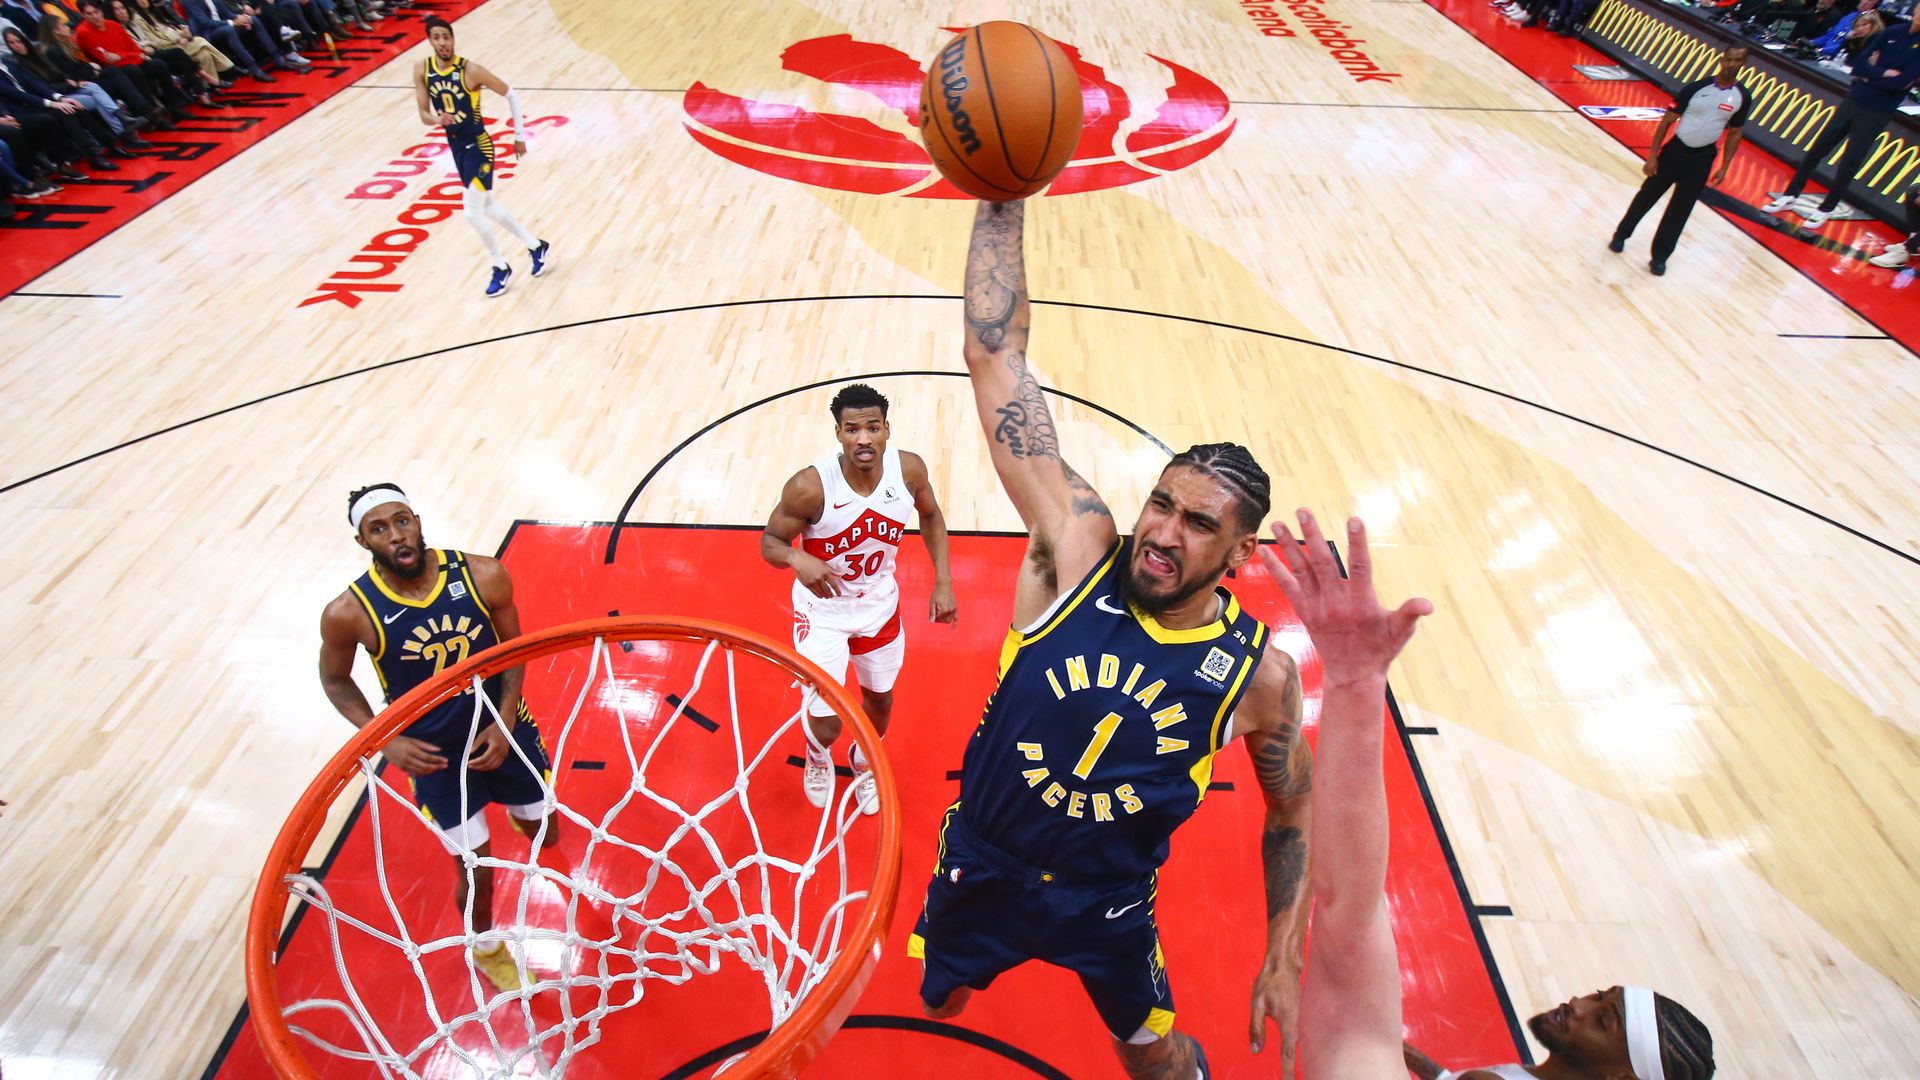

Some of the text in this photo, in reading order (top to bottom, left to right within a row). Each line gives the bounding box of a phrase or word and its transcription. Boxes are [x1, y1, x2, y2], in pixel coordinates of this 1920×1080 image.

[441, 93, 456, 113] 0
[940, 36, 982, 156] Wilson
[825, 518, 904, 554] RAPTORS
[841, 550, 885, 581] 30
[400, 614, 484, 660] INDIANA
[422, 635, 470, 676] 22
[1233, 630, 1247, 645] 30
[1193, 669, 1225, 690] spokenote
[1045, 653, 1190, 755] INDIANA
[1072, 711, 1124, 780] 1
[1017, 742, 1144, 822] PACERS
